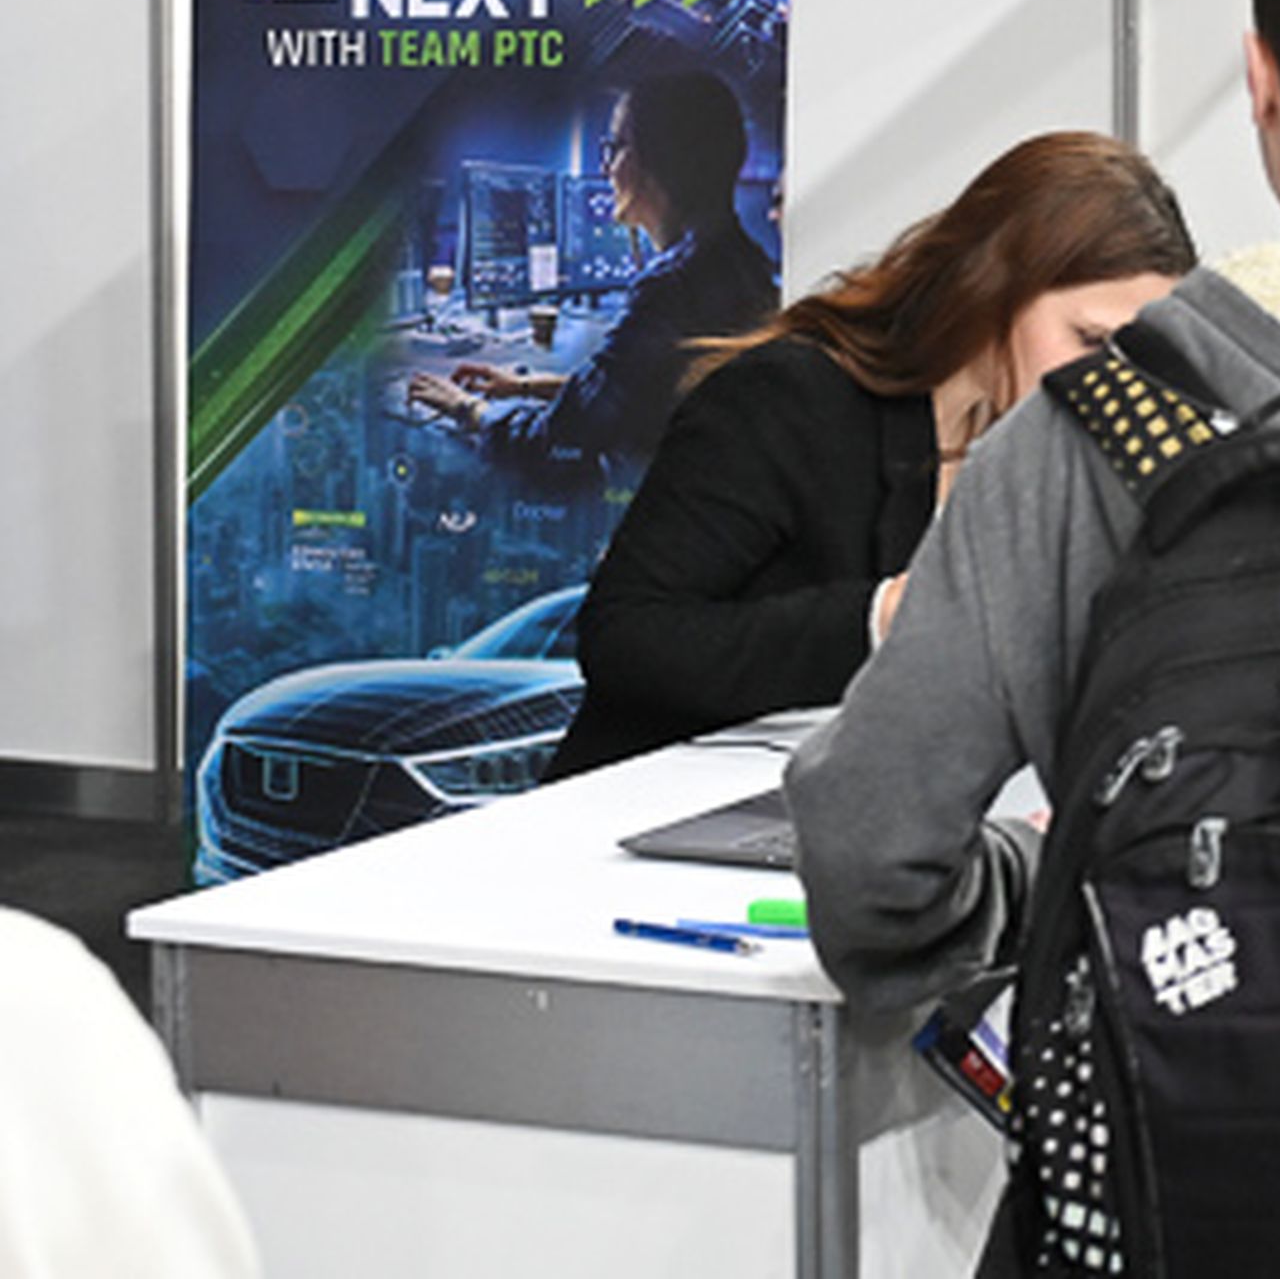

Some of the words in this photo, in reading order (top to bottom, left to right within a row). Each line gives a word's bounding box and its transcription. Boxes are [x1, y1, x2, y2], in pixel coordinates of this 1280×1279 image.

[267, 30, 366, 66] WITH
[378, 30, 481, 66] TEAM
[493, 30, 564, 66] PTC
